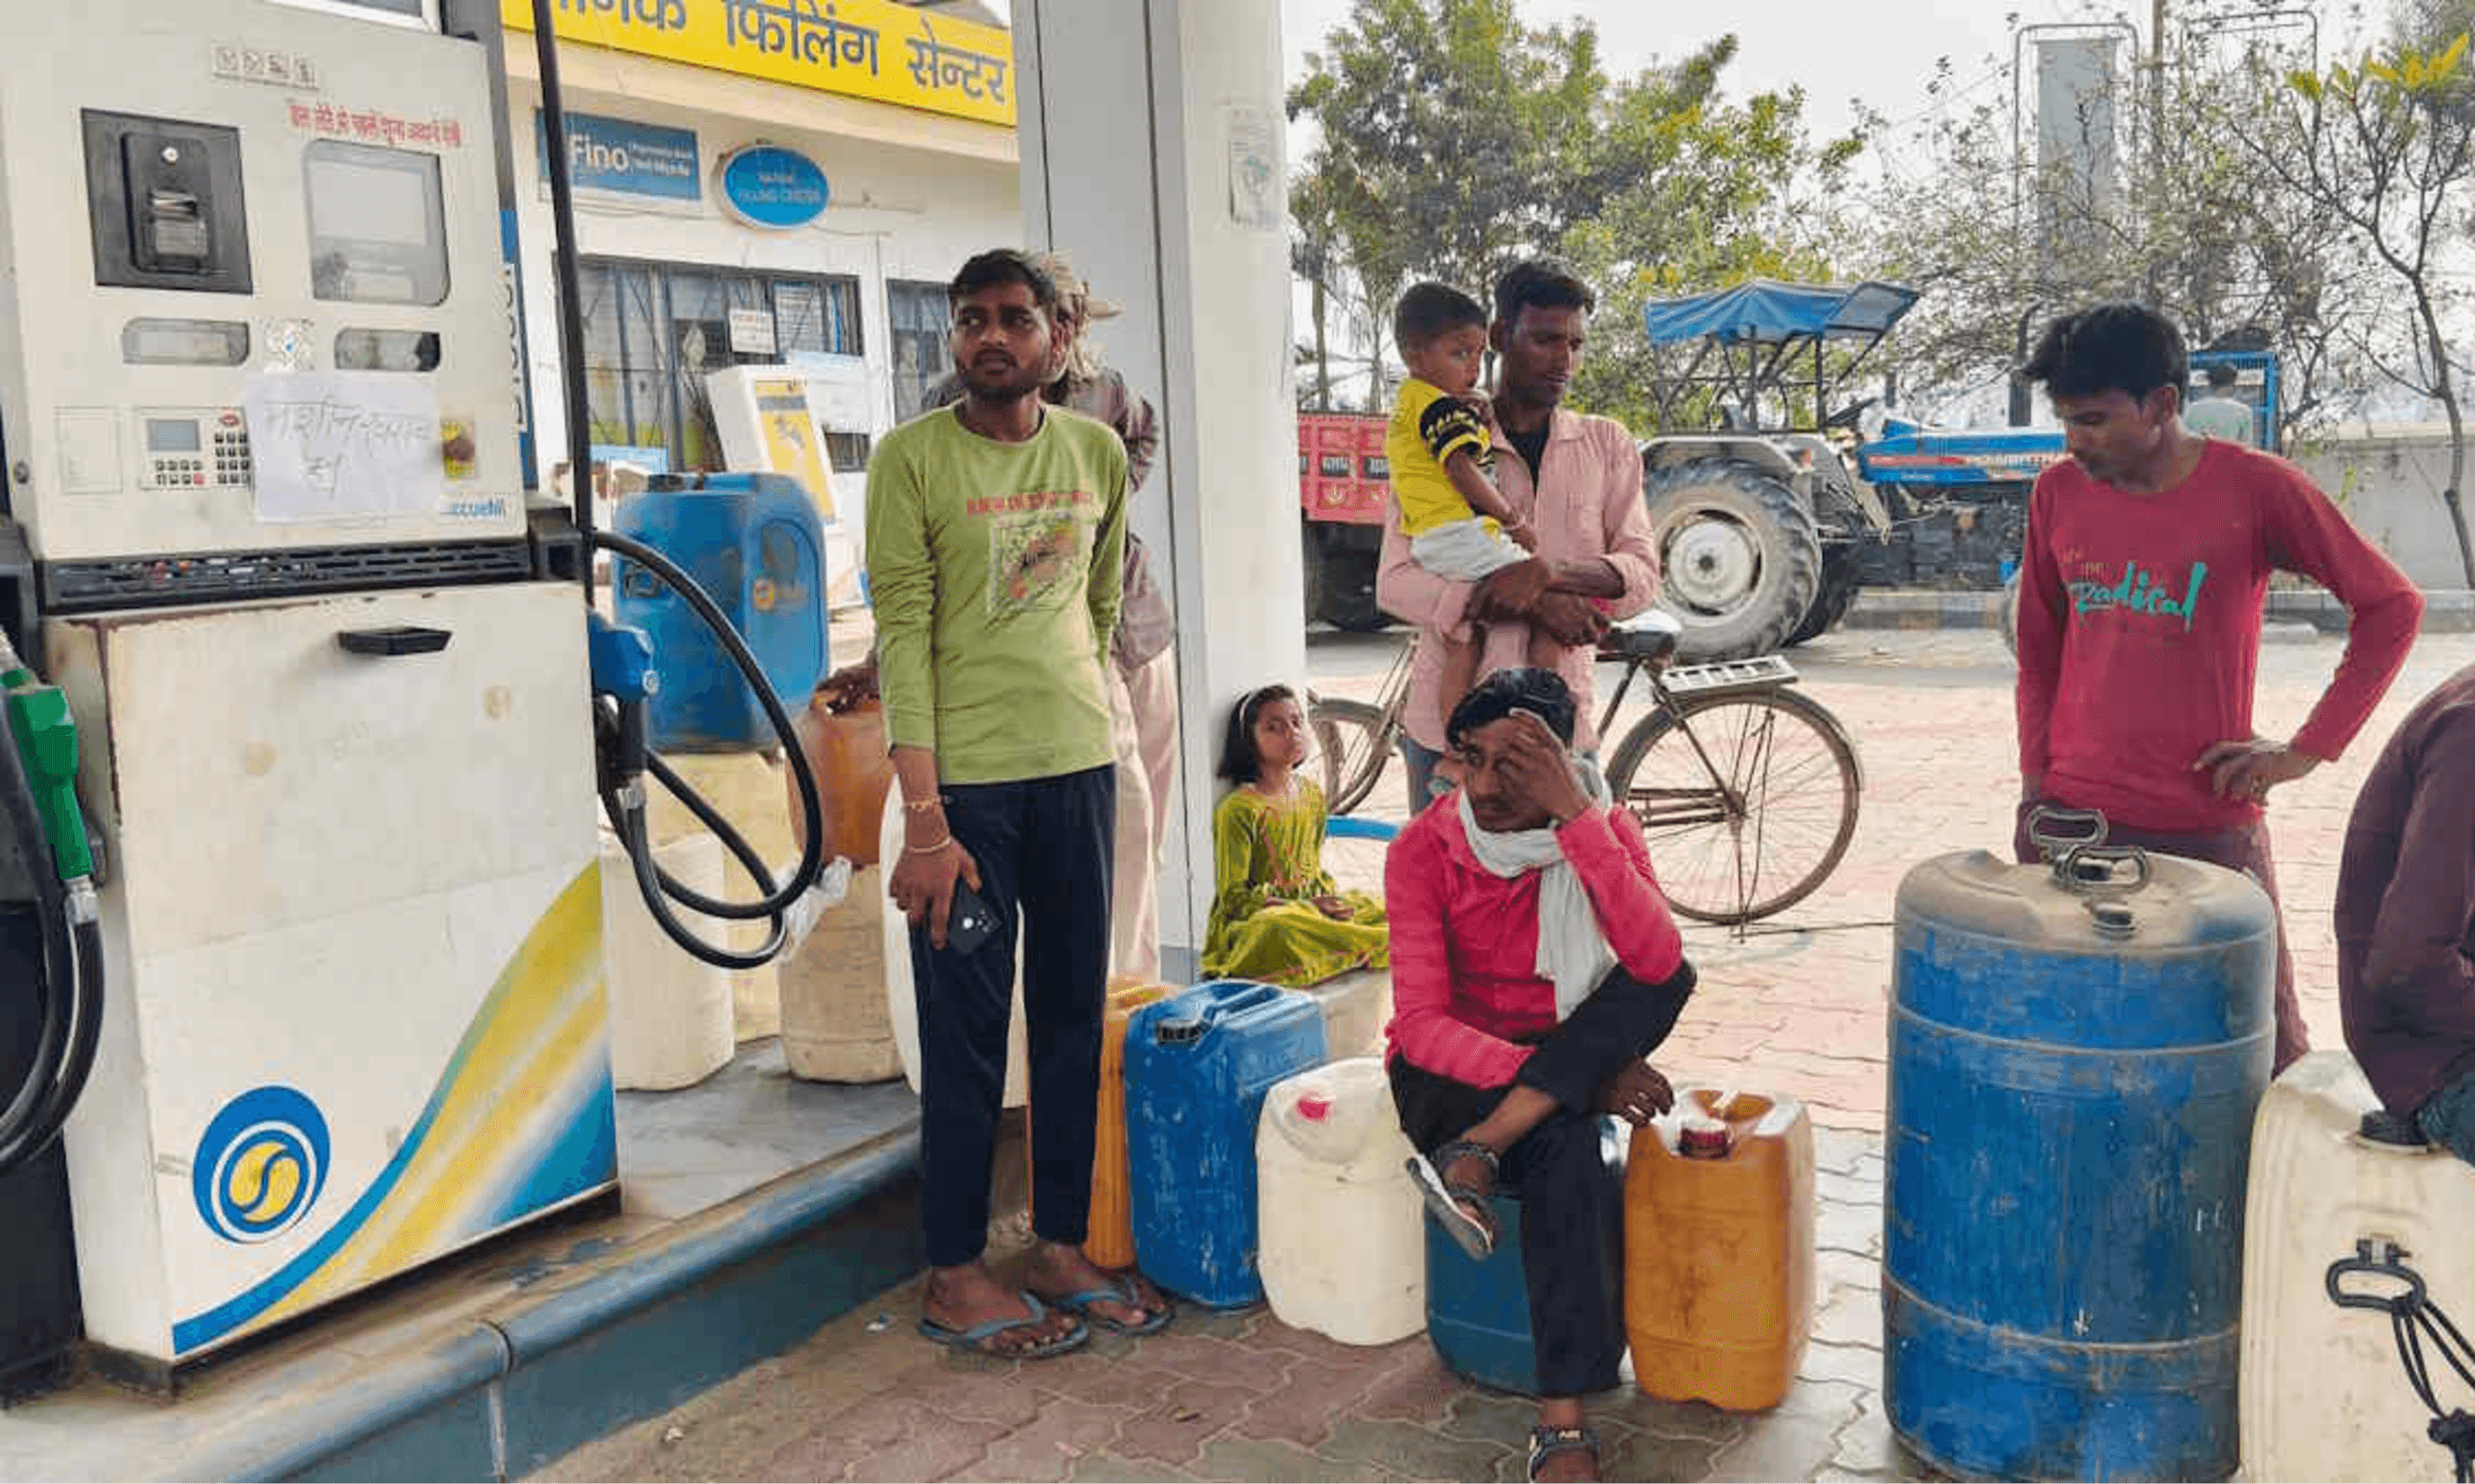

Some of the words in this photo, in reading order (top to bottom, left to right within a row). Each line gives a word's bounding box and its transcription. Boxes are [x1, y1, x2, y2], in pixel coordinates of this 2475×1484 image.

[725, 0, 879, 76] फिलिंग
[906, 17, 1006, 103] सेन्टर
[571, 132, 629, 172] Fino
[2066, 561, 2208, 633] Radical
